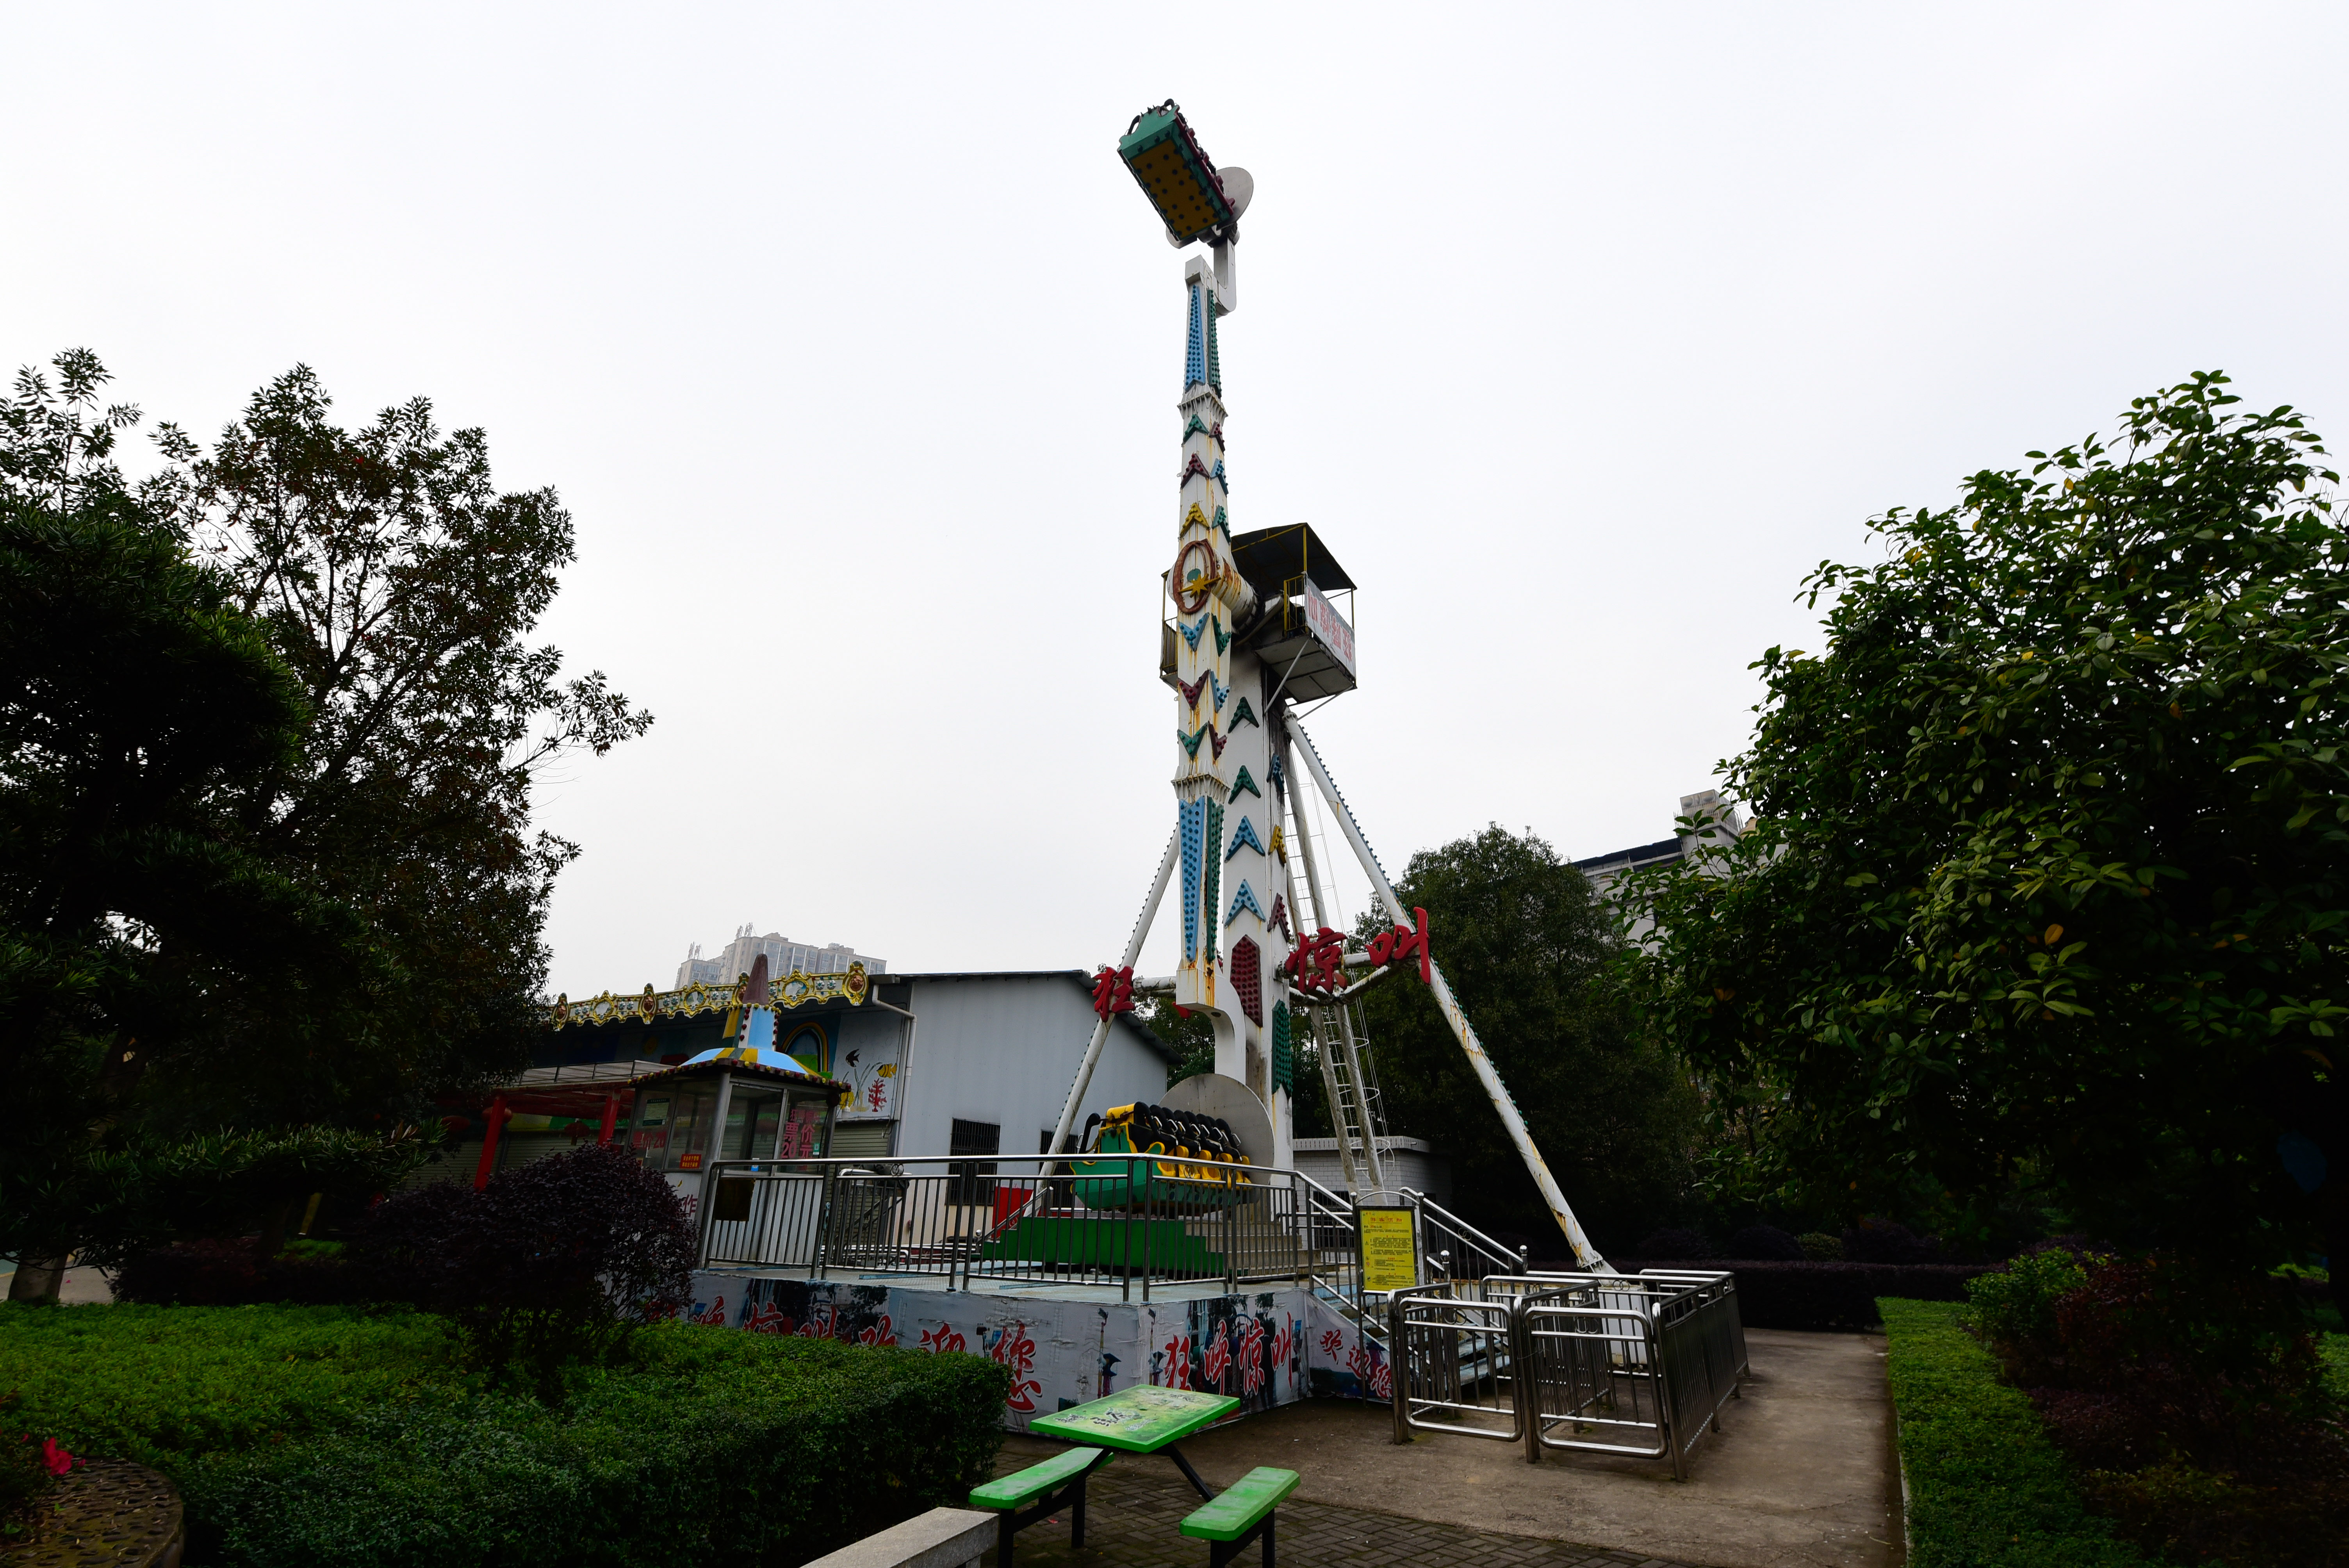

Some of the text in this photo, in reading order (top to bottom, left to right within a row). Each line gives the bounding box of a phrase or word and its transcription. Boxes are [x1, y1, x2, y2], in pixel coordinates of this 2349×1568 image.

[784, 1121, 815, 1142] 票价
[1165, 1311, 1293, 1396] 狂呼惊叫
